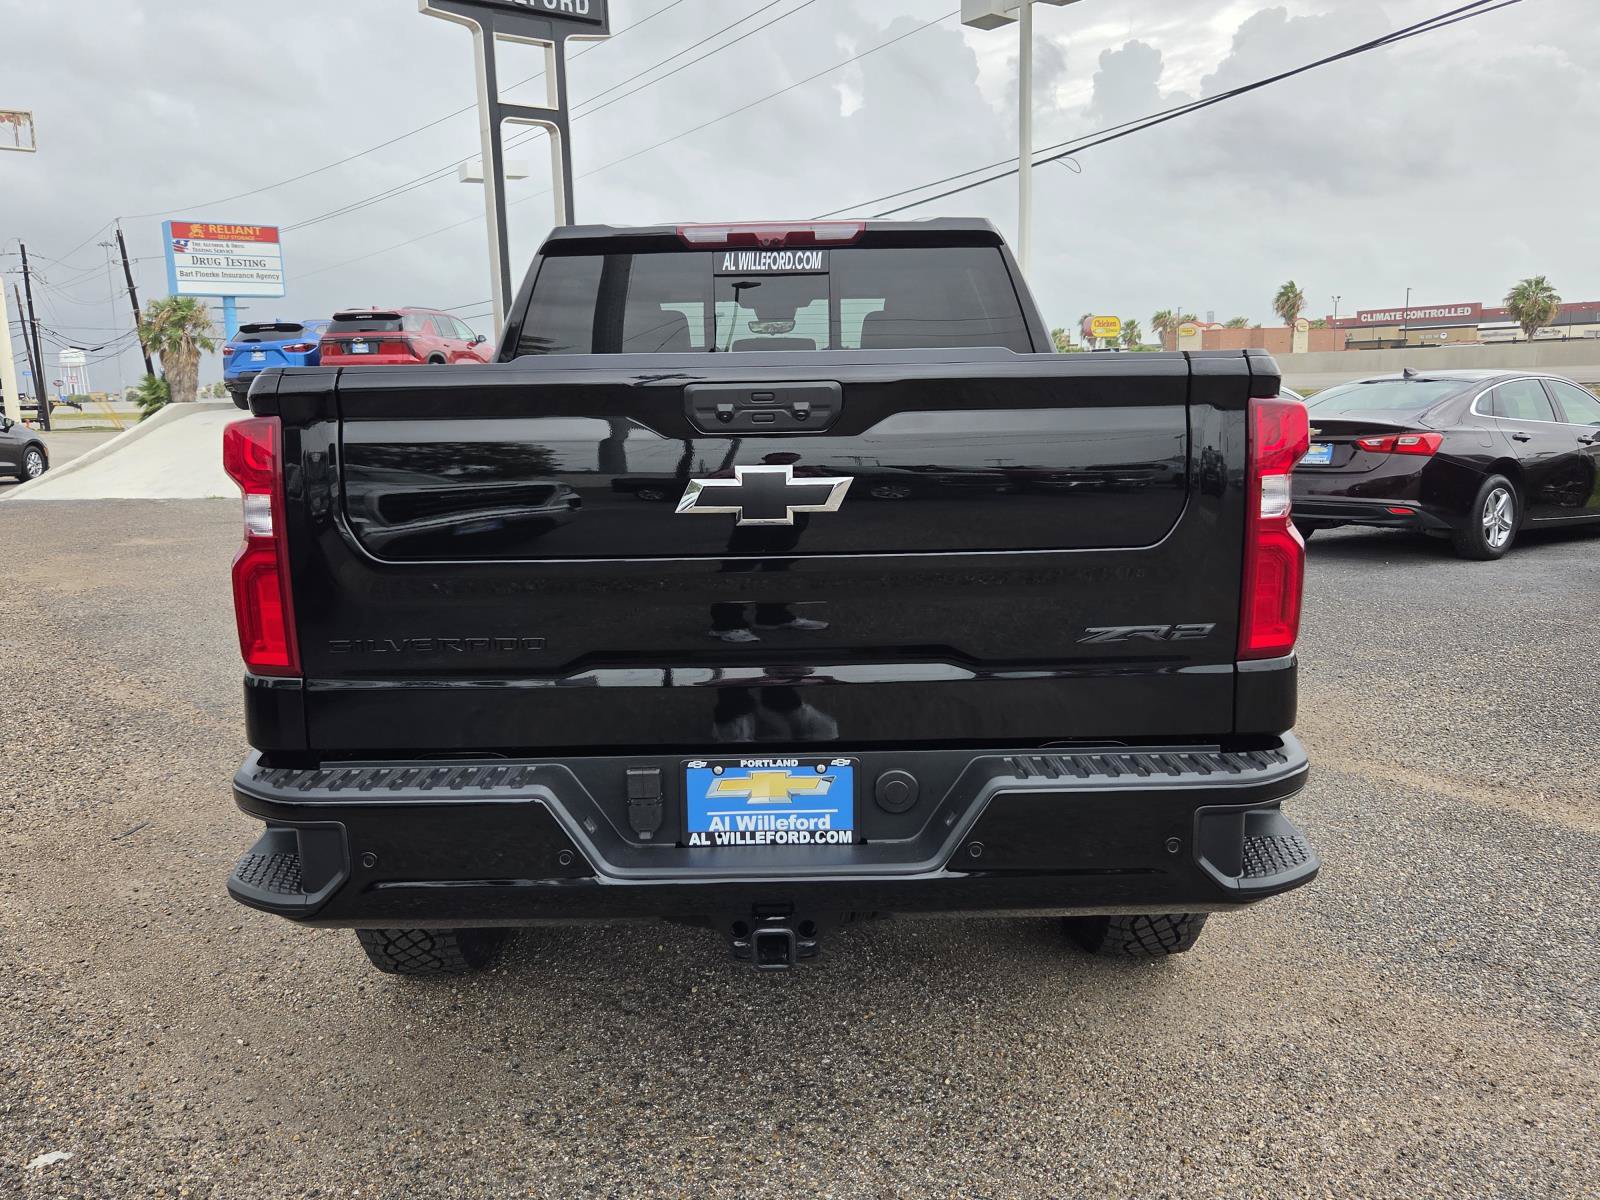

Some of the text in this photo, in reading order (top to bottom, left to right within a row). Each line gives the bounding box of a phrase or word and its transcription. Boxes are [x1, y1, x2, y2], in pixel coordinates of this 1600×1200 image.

[209, 224, 261, 236] RELIANT
[191, 255, 266, 268] DRUG TESTING
[722, 251, 822, 271] AL WILLEFORD.COM
[255, 273, 280, 281] Agency
[1361, 307, 1472, 322] CLIMATE CONTROLLED
[1075, 623, 1217, 644] ZR2
[327, 637, 546, 653] SILVERADO
[740, 759, 799, 768] PORTLAND
[708, 814, 831, 832] Al Willeford
[688, 830, 853, 846] AL WILLEFORD.COM
